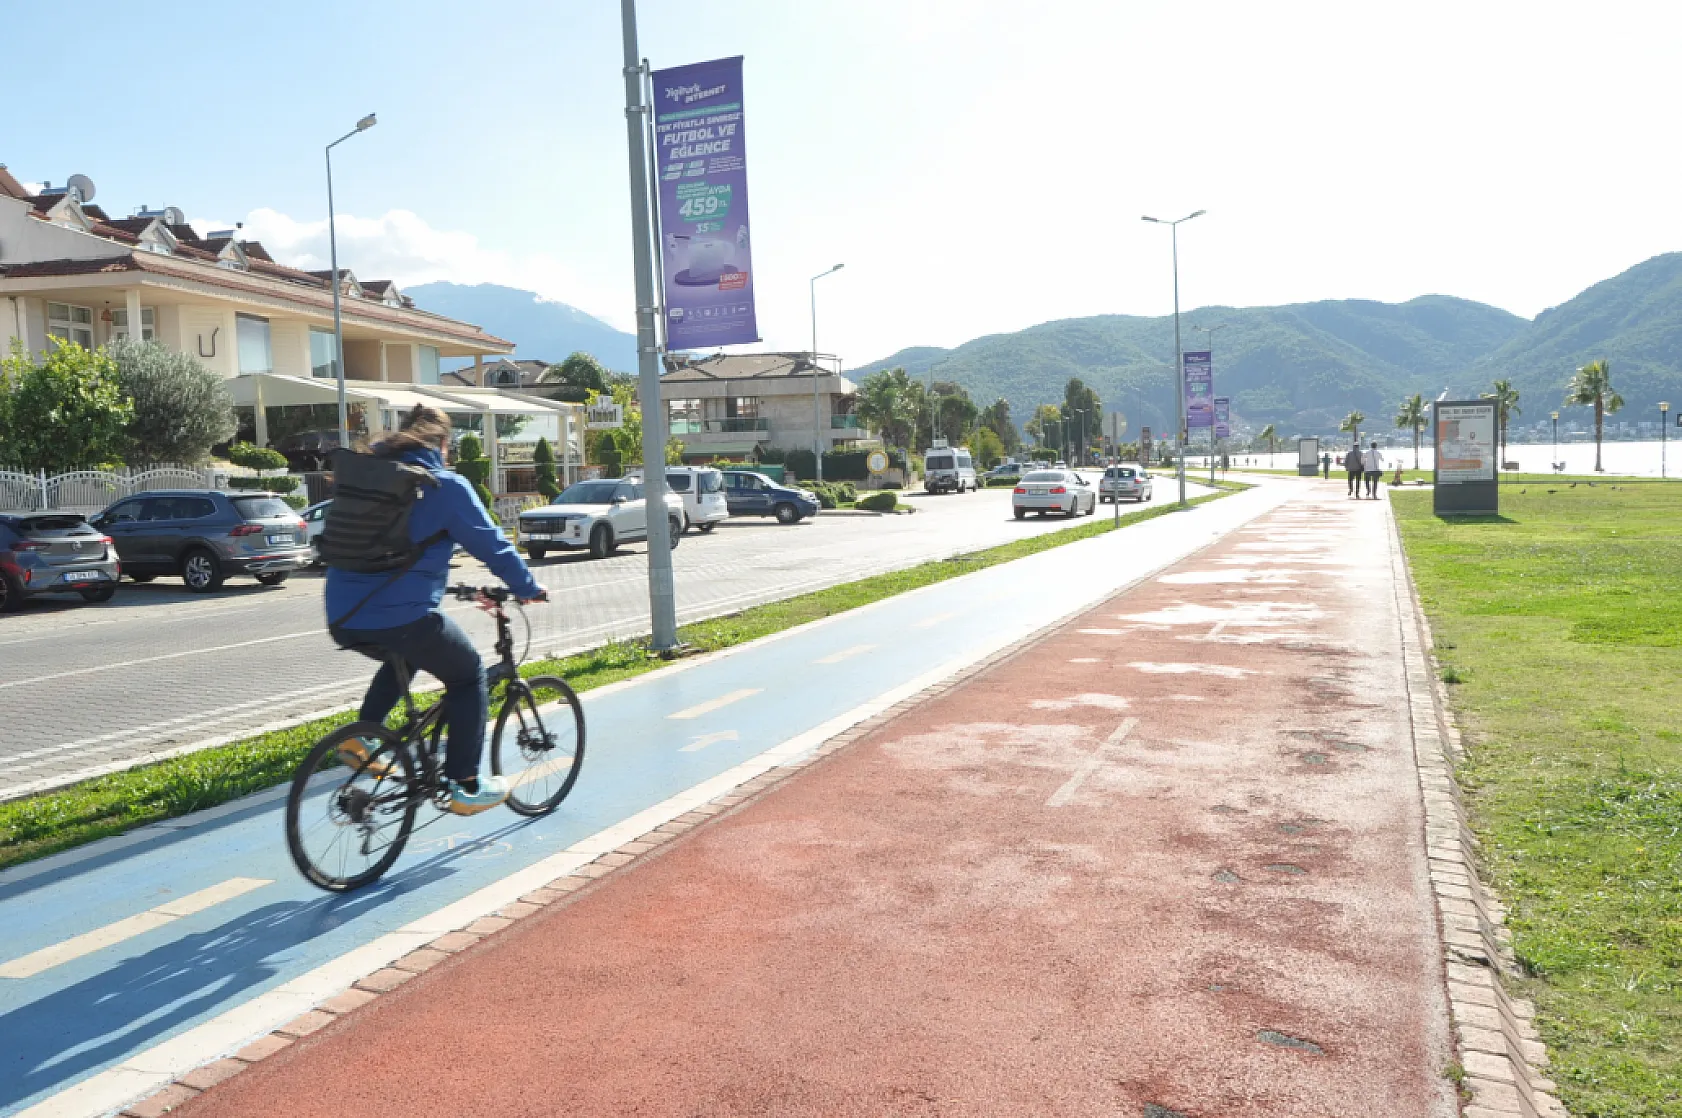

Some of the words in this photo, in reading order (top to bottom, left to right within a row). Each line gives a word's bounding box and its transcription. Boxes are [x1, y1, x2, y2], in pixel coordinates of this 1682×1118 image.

[663, 127, 714, 145] FUTBOL
[718, 124, 736, 137] VE
[670, 139, 731, 159] EĞLENCE
[679, 196, 718, 217] 459
[695, 223, 710, 234] 35
